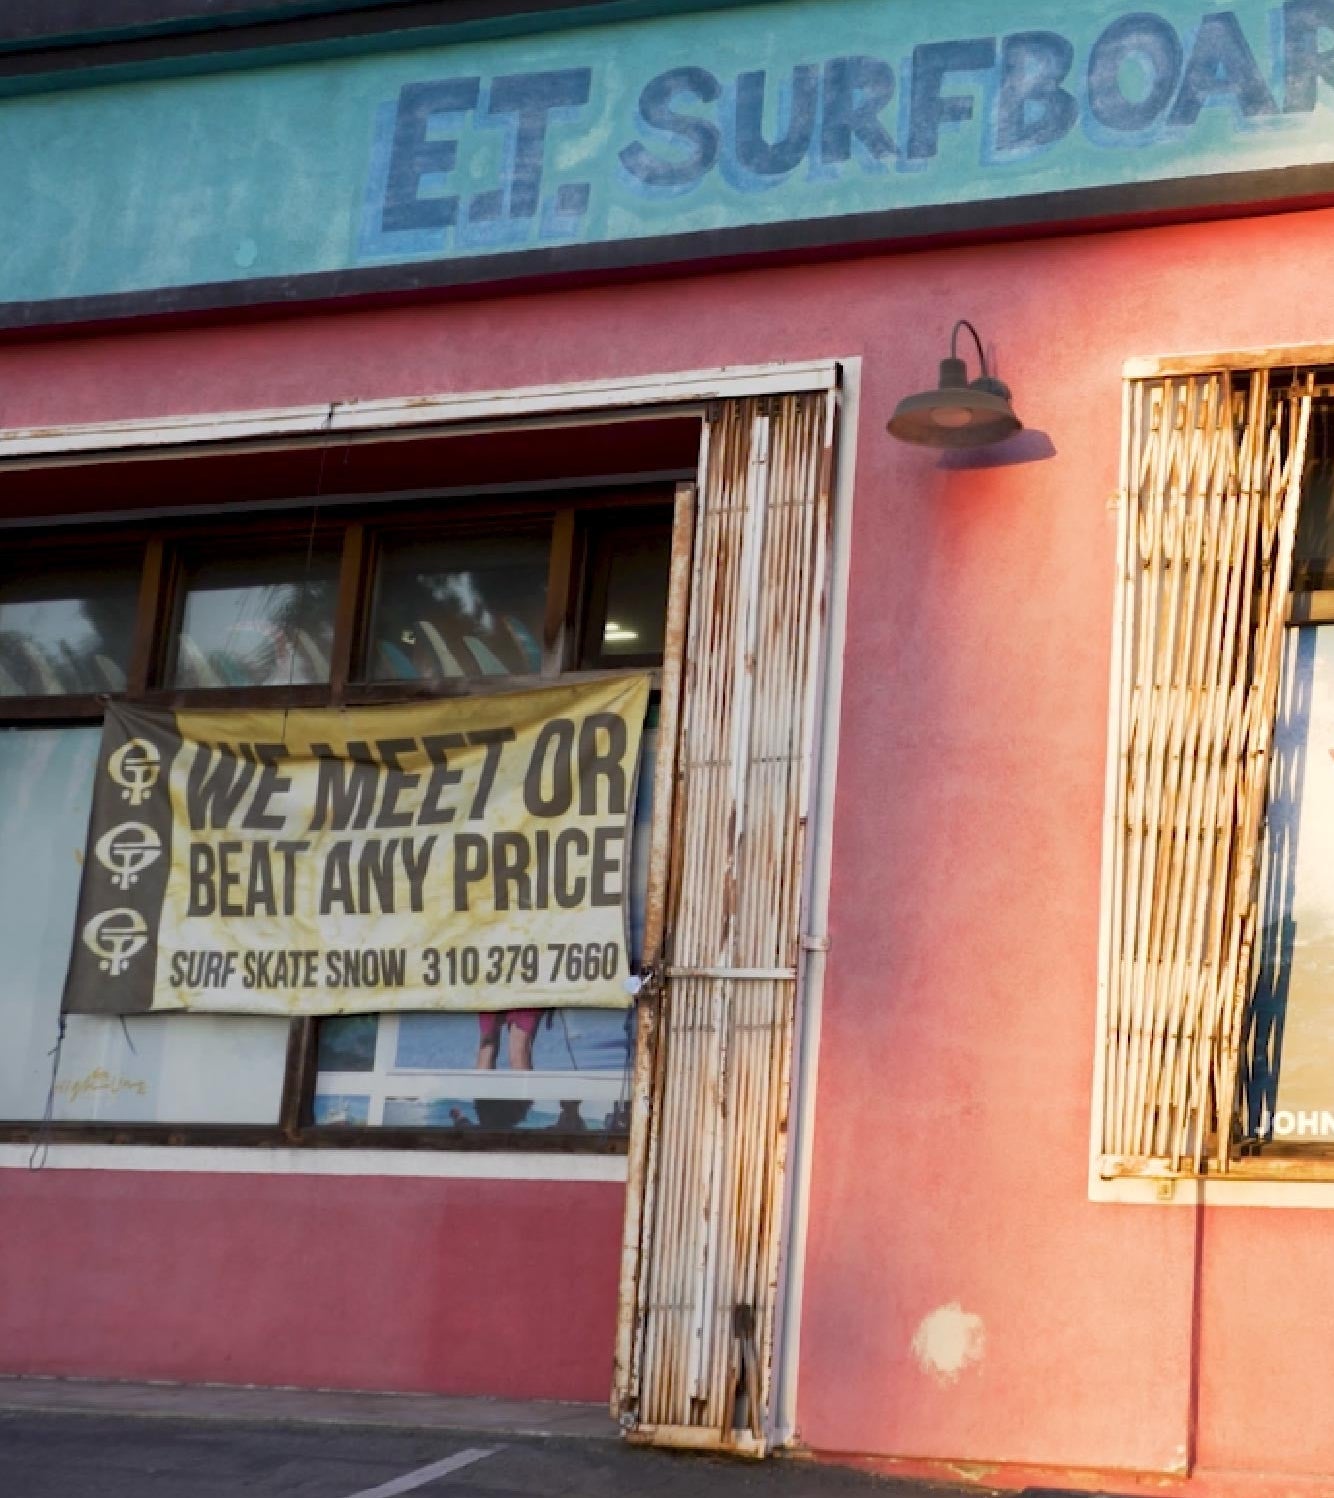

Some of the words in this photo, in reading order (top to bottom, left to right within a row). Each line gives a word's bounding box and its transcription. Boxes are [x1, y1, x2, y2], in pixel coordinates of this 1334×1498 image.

[376, 66, 592, 236] E.T.
[186, 741, 293, 831] WE
[308, 726, 516, 832] MEET
[524, 711, 628, 819] OR
[186, 839, 311, 918] BEAT
[318, 834, 439, 916] ANY
[452, 826, 627, 912] PRICE
[169, 950, 239, 989] SURF
[241, 949, 320, 990] SKATE
[325, 947, 408, 989] SNOW
[422, 946, 480, 987] 310
[485, 943, 540, 985] 379
[548, 940, 620, 983] 7660
